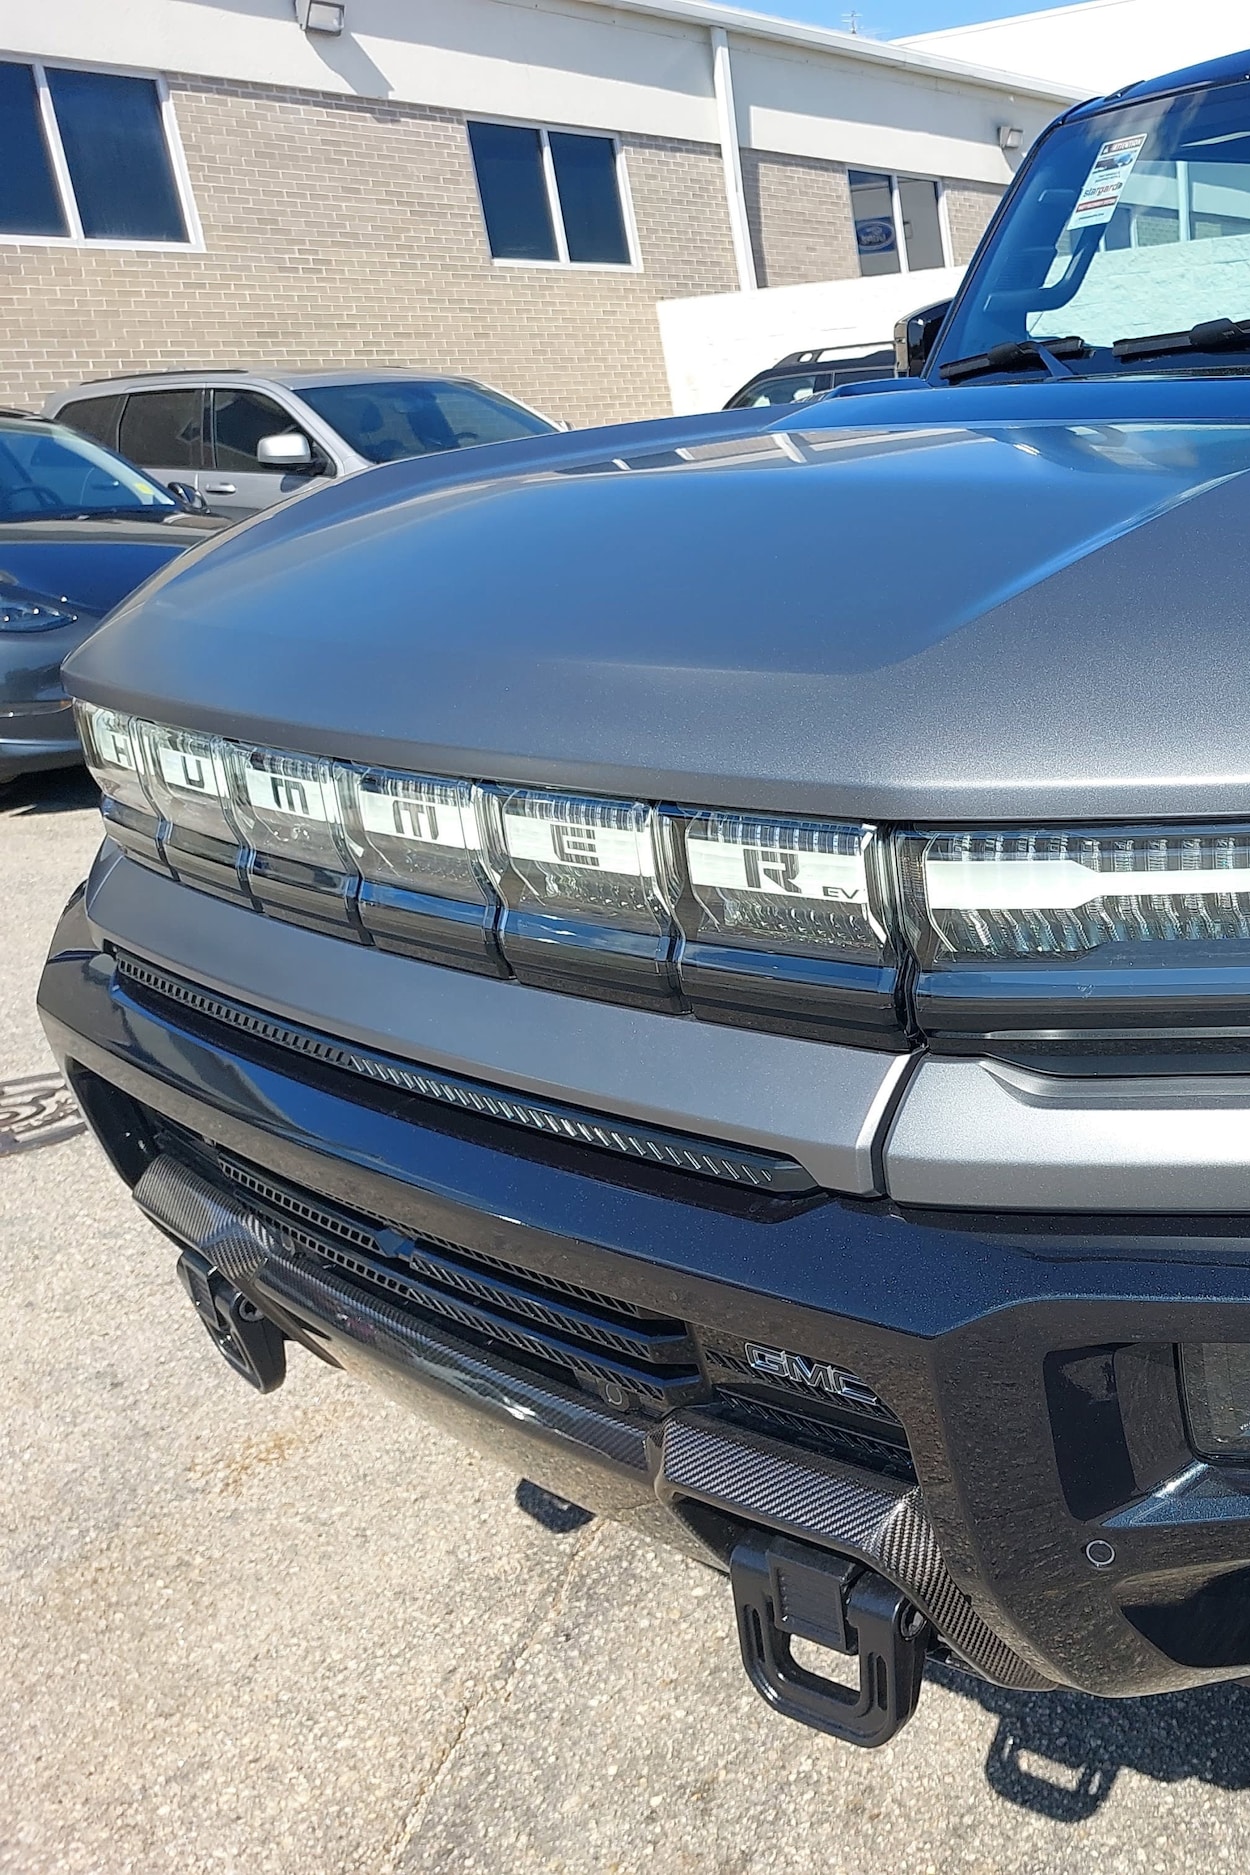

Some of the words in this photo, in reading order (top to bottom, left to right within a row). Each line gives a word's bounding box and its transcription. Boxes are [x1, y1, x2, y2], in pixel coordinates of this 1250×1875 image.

[112, 733, 802, 894] HUMMER
[822, 885, 861, 900] EV
[745, 1342, 878, 1405] GMC
